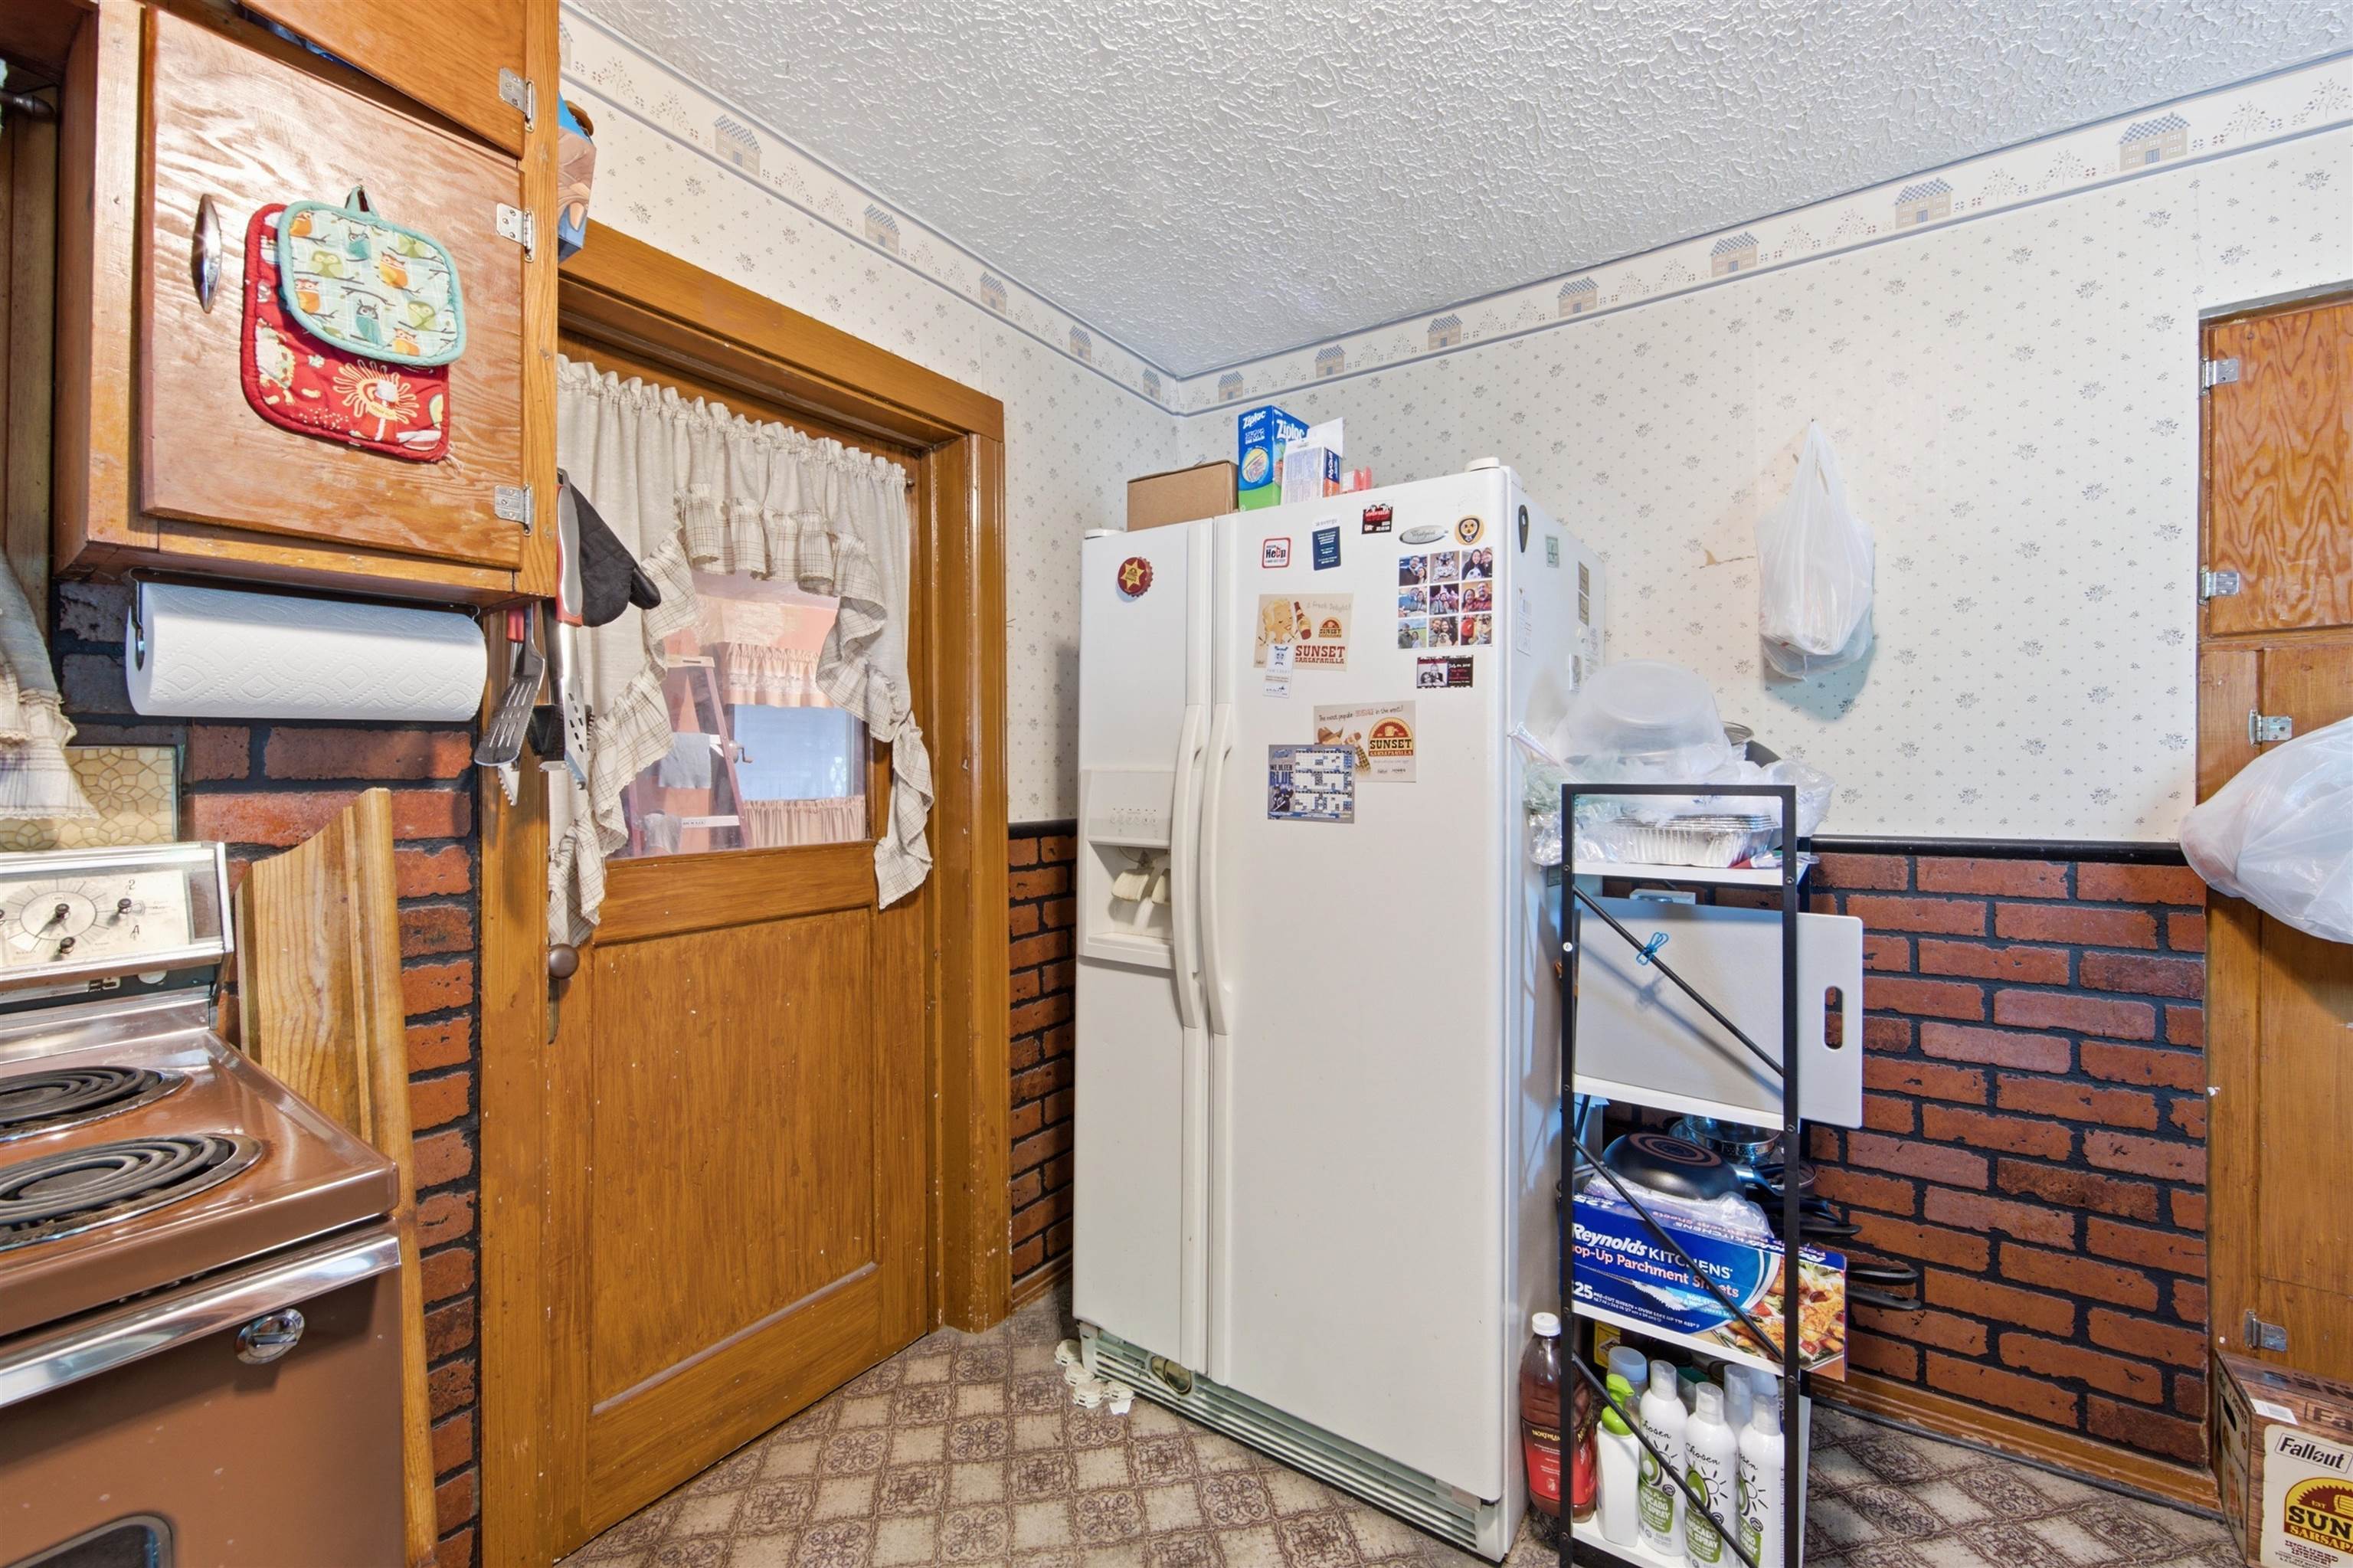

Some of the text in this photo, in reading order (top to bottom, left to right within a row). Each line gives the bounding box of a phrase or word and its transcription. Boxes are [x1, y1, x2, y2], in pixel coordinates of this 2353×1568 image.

[1242, 411, 1266, 430] Ziploc
[1276, 419, 1305, 441] Ziploc
[1295, 645, 1346, 658] SUNSET
[1370, 739, 1412, 749] SUNSET
[1270, 771, 1293, 786] BLUE
[1572, 1223, 1731, 1279] Reynolds KITCENS
[1617, 1254, 1689, 1285] Parchment
[1693, 1275, 1739, 1298] Shets
[1643, 1421, 1671, 1439] hosen
[1685, 1442, 1720, 1465] Chosen
[2279, 1437, 2345, 1469] Fallout
[2289, 1505, 2351, 1540] SUN
